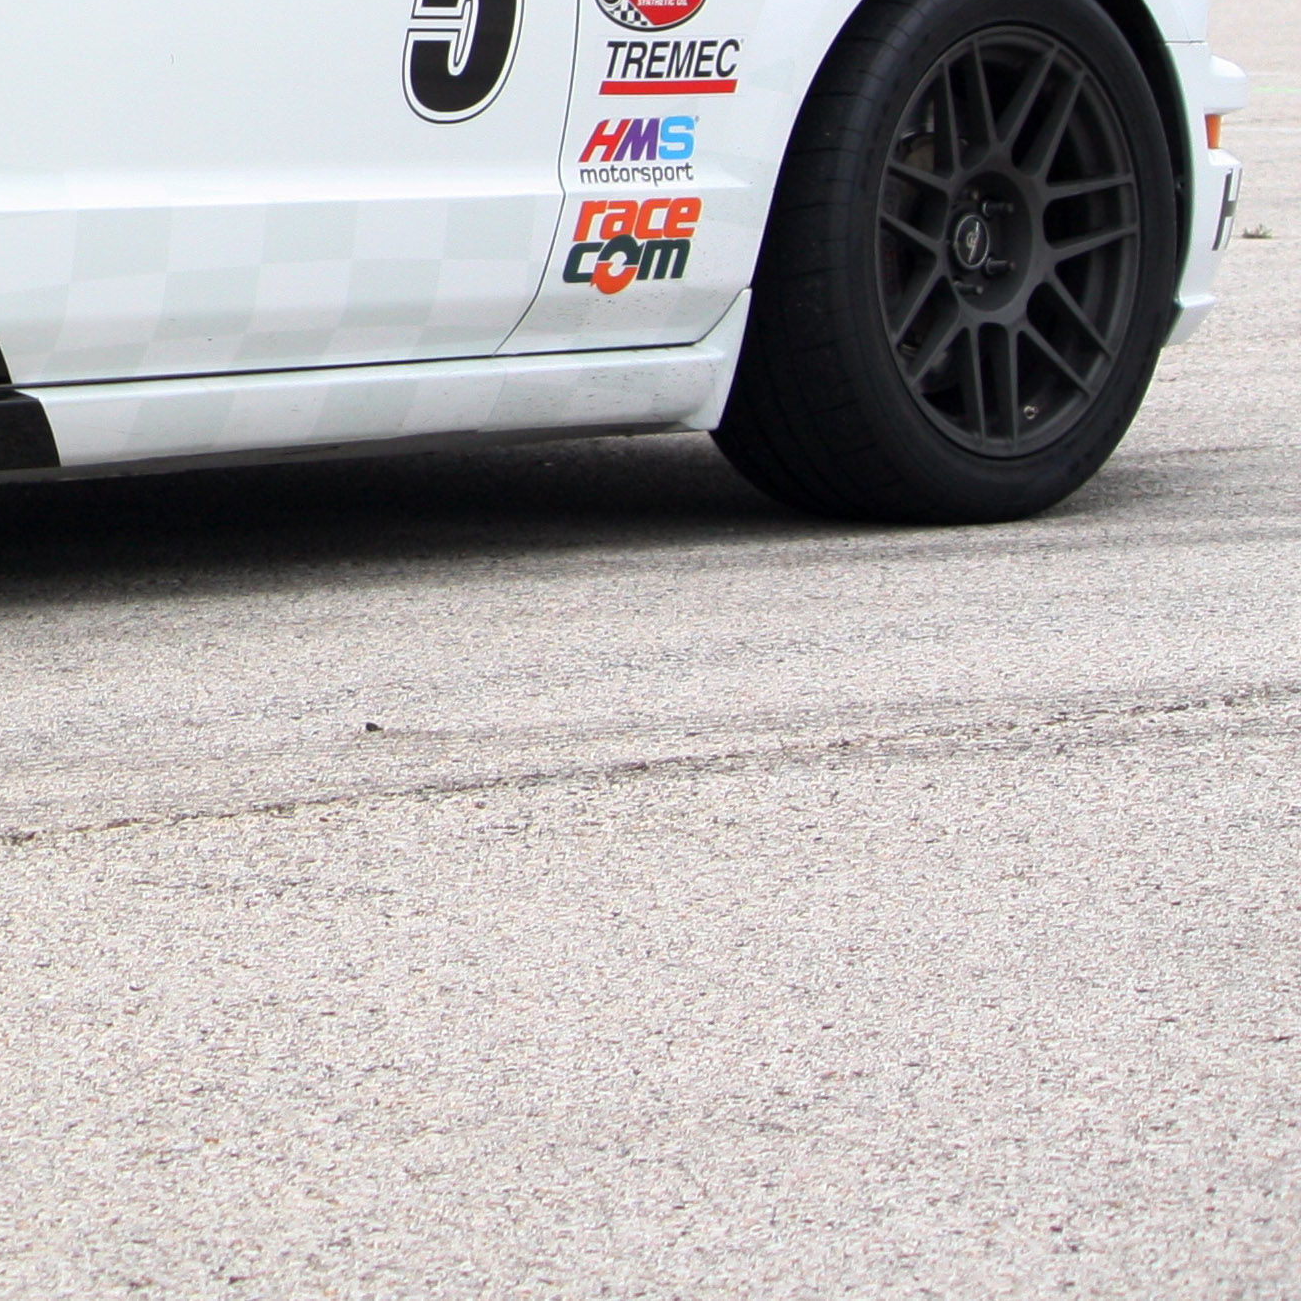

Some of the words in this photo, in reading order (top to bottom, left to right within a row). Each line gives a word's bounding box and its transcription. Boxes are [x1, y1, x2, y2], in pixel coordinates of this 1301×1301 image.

[606, 38, 741, 79] TREMEC
[578, 115, 696, 163] HMS
[580, 162, 695, 187] motorsport
[572, 197, 702, 243] race
